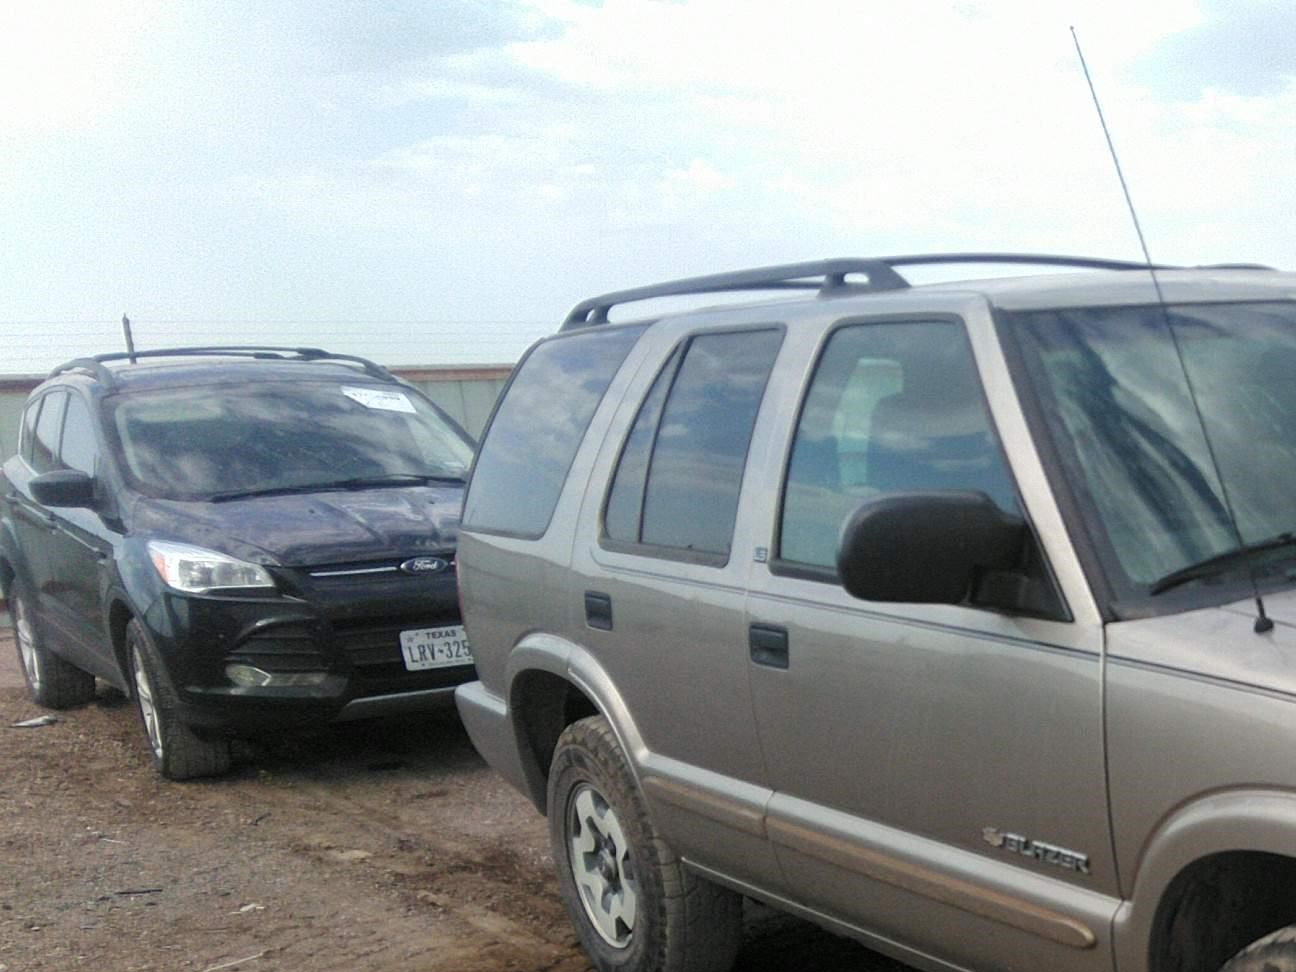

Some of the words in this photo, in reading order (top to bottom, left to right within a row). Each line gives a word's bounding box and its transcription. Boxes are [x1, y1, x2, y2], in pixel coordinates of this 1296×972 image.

[412, 559, 439, 571] Ford
[424, 629, 457, 640] TEXAS
[1005, 832, 1089, 874] BLAZER
